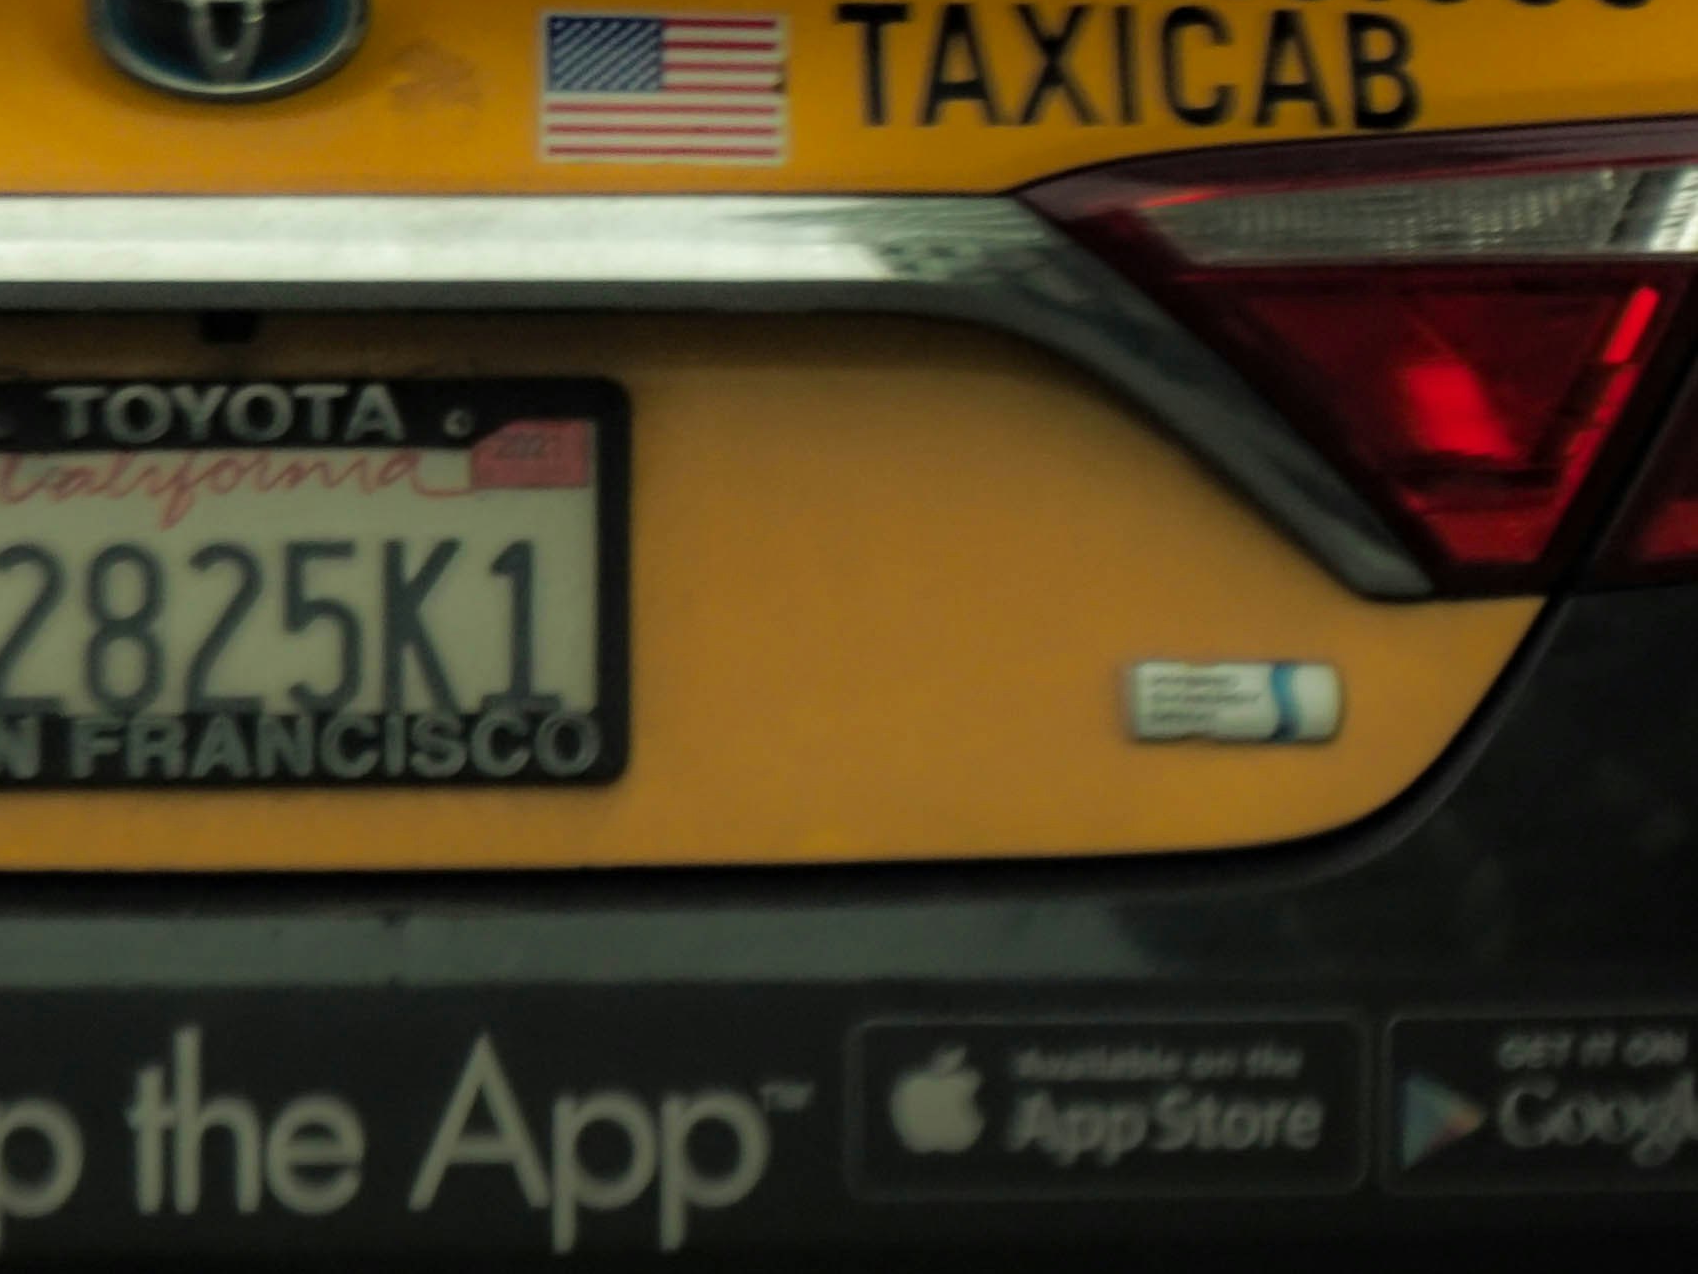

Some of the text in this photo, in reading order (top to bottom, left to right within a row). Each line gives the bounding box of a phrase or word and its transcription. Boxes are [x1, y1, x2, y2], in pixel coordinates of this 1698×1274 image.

[835, 0, 1423, 132] TAXICAB
[44, 383, 406, 443] TOYOTA
[68, 708, 604, 781] FRANCISCO
[125, 1025, 367, 1216] the
[407, 1030, 771, 1252] App
[1498, 1071, 1698, 1168] Googl
